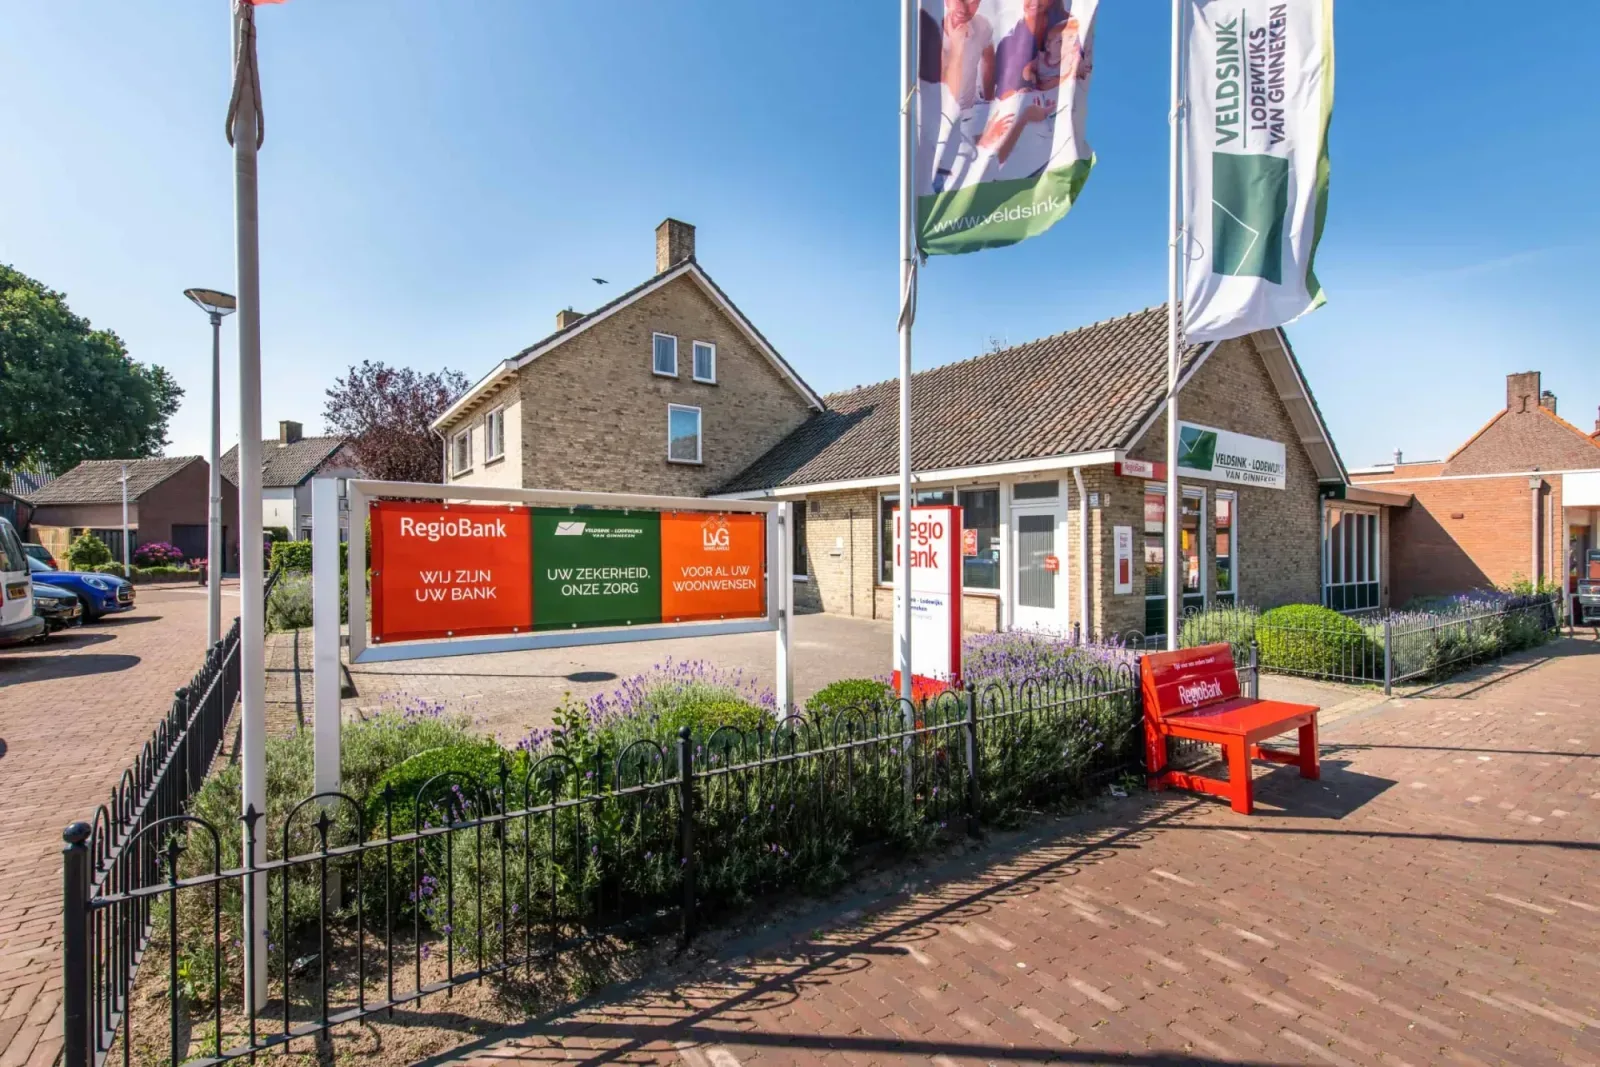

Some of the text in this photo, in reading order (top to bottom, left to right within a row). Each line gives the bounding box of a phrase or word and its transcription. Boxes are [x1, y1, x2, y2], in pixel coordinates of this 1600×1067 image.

[1215, 17, 1239, 146] VELDSINK
[1249, 27, 1267, 130] LODEWIJKS
[1267, 3, 1288, 145] VAN GINNEKEN
[1215, 452, 1247, 468] VELDSINK
[1226, 470, 1240, 480] VAN
[400, 516, 507, 542] RegioBank
[897, 515, 944, 546] egio
[897, 544, 939, 568] ank
[419, 569, 491, 584] WIJ ZIJN
[547, 567, 651, 581] UW ZEKERHEID.
[680, 565, 750, 578] VOOR AL UW
[561, 582, 639, 596] ONZE ZORG
[672, 579, 757, 592] WOONWENSEN
[415, 586, 497, 602] UW BANK
[1178, 678, 1223, 707] RegioBank
